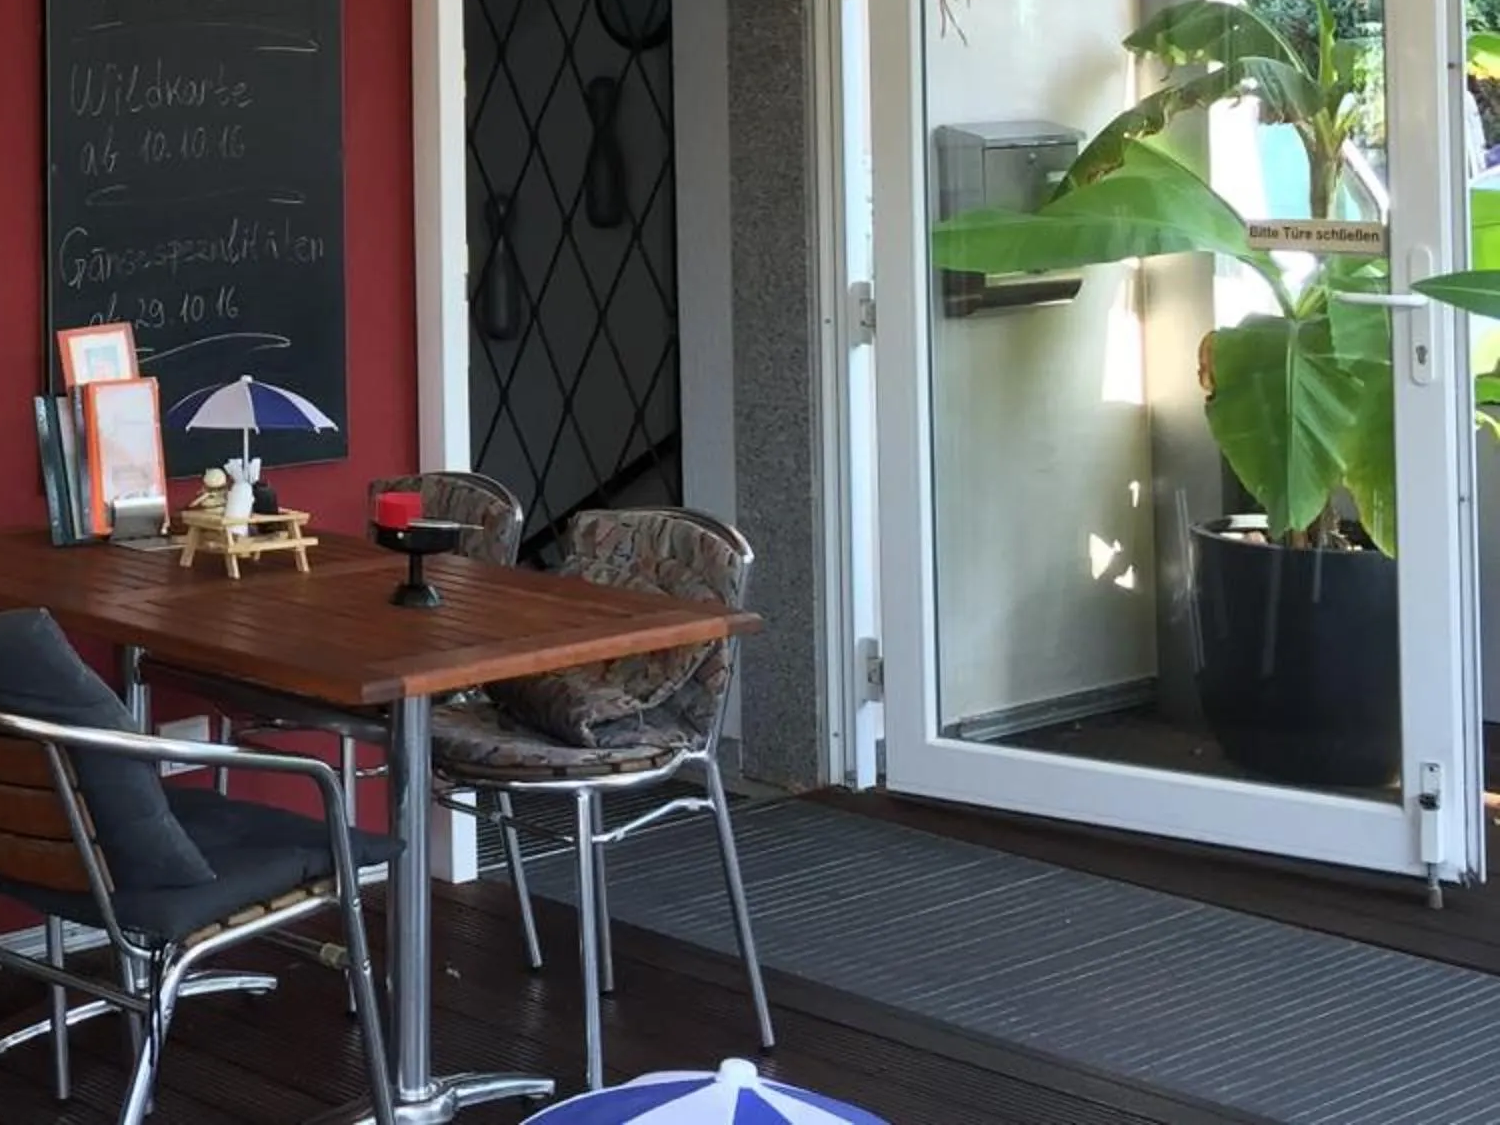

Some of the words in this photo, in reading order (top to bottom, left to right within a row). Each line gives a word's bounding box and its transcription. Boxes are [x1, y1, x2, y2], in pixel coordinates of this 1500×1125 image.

[71, 57, 253, 117] Wildkarte
[80, 130, 119, 176] ab
[1249, 226, 1279, 239] Bitte
[1282, 225, 1313, 241] Türe
[1316, 227, 1380, 243] schließen
